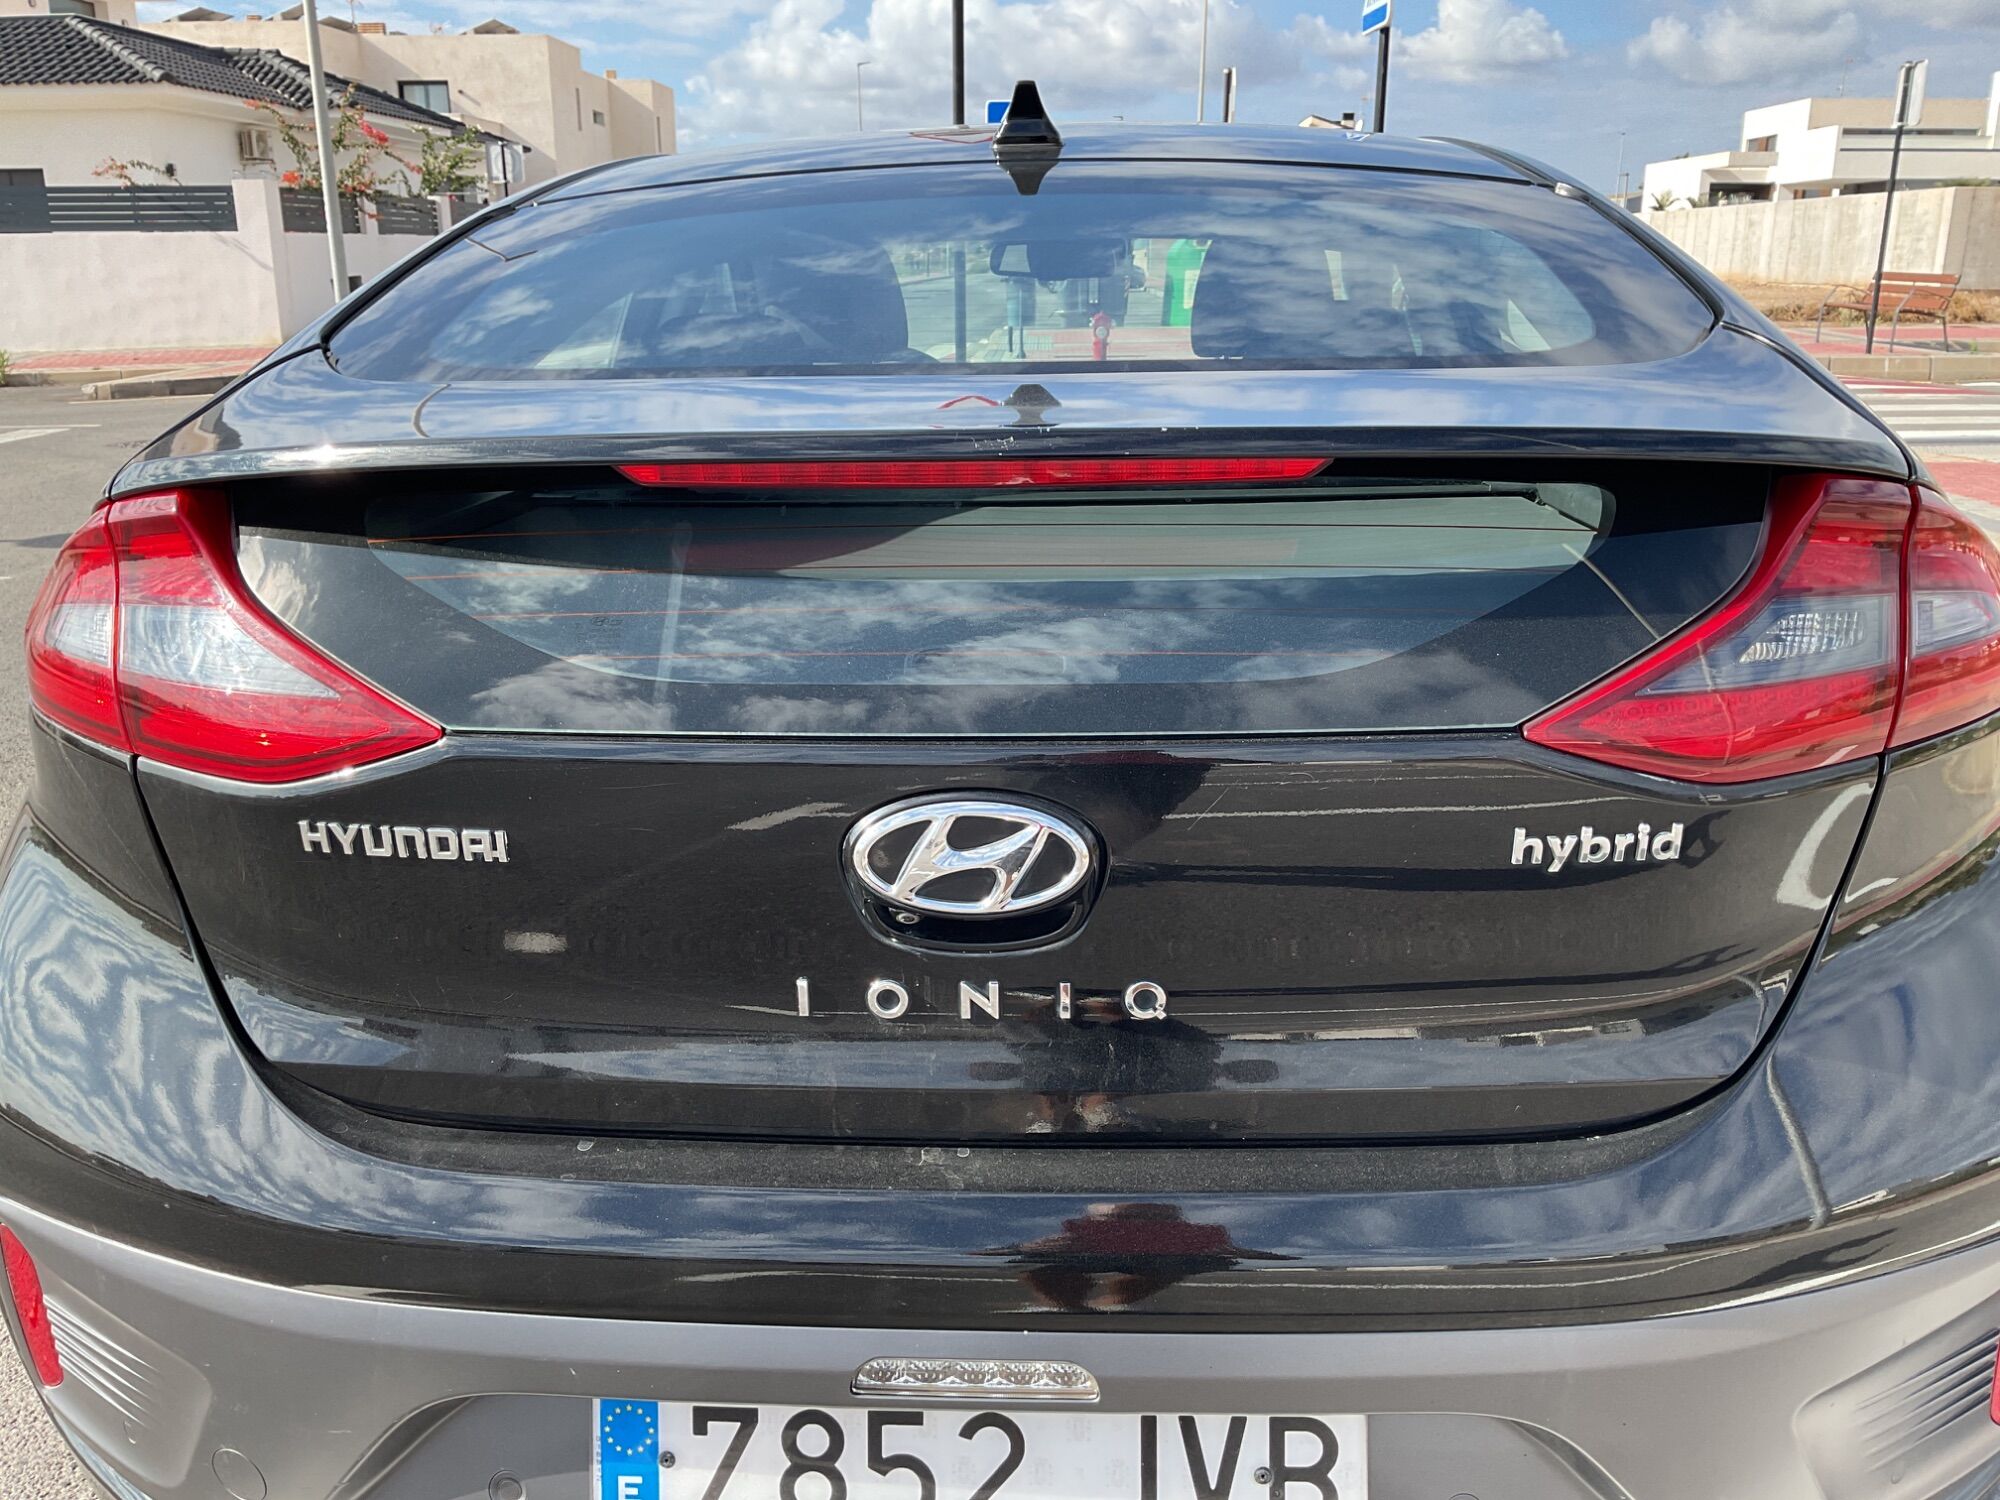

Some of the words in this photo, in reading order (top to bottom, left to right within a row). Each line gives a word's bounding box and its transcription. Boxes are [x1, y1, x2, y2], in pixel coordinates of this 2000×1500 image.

[298, 820, 510, 862] HYUNDAI
[1511, 822, 1684, 872] hybrid
[796, 977, 1167, 1020] IONIQ
[692, 1405, 1025, 1500] 7852
[617, 1475, 643, 1500] E
